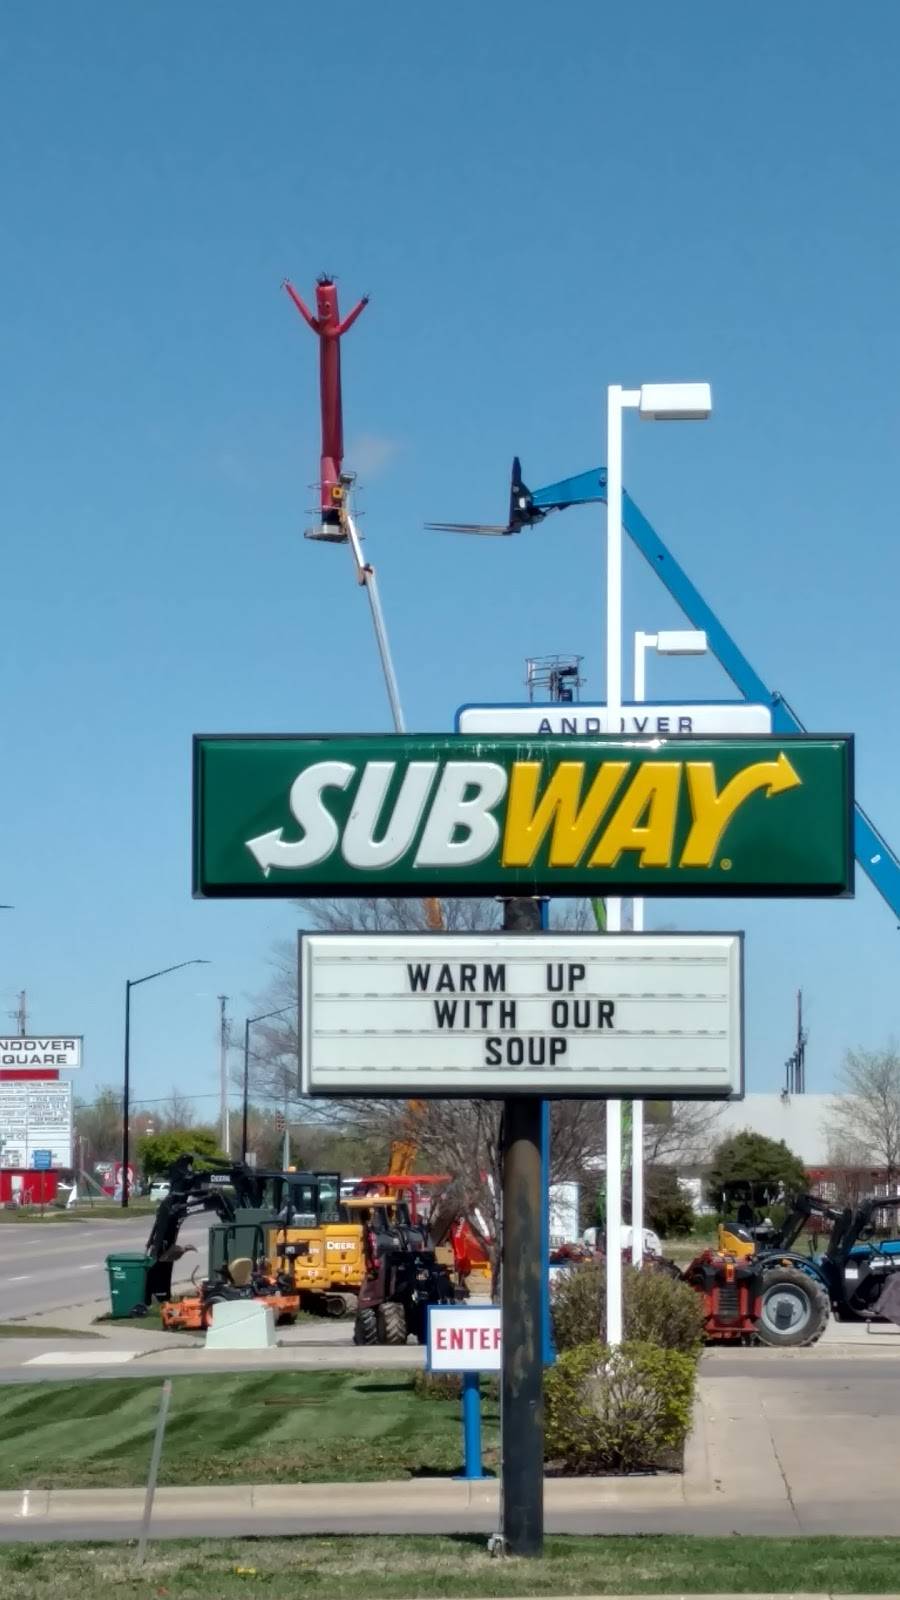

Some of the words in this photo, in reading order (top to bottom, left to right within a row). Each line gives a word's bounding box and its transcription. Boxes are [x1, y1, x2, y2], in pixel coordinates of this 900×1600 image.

[538, 716, 693, 734] ANDVER
[245, 753, 802, 877] SUBWAY
[407, 963, 506, 992] WARM
[547, 963, 585, 992] UP
[434, 1000, 516, 1029] WITH
[551, 1000, 615, 1029] OUR
[485, 1036, 567, 1066] SOUP
